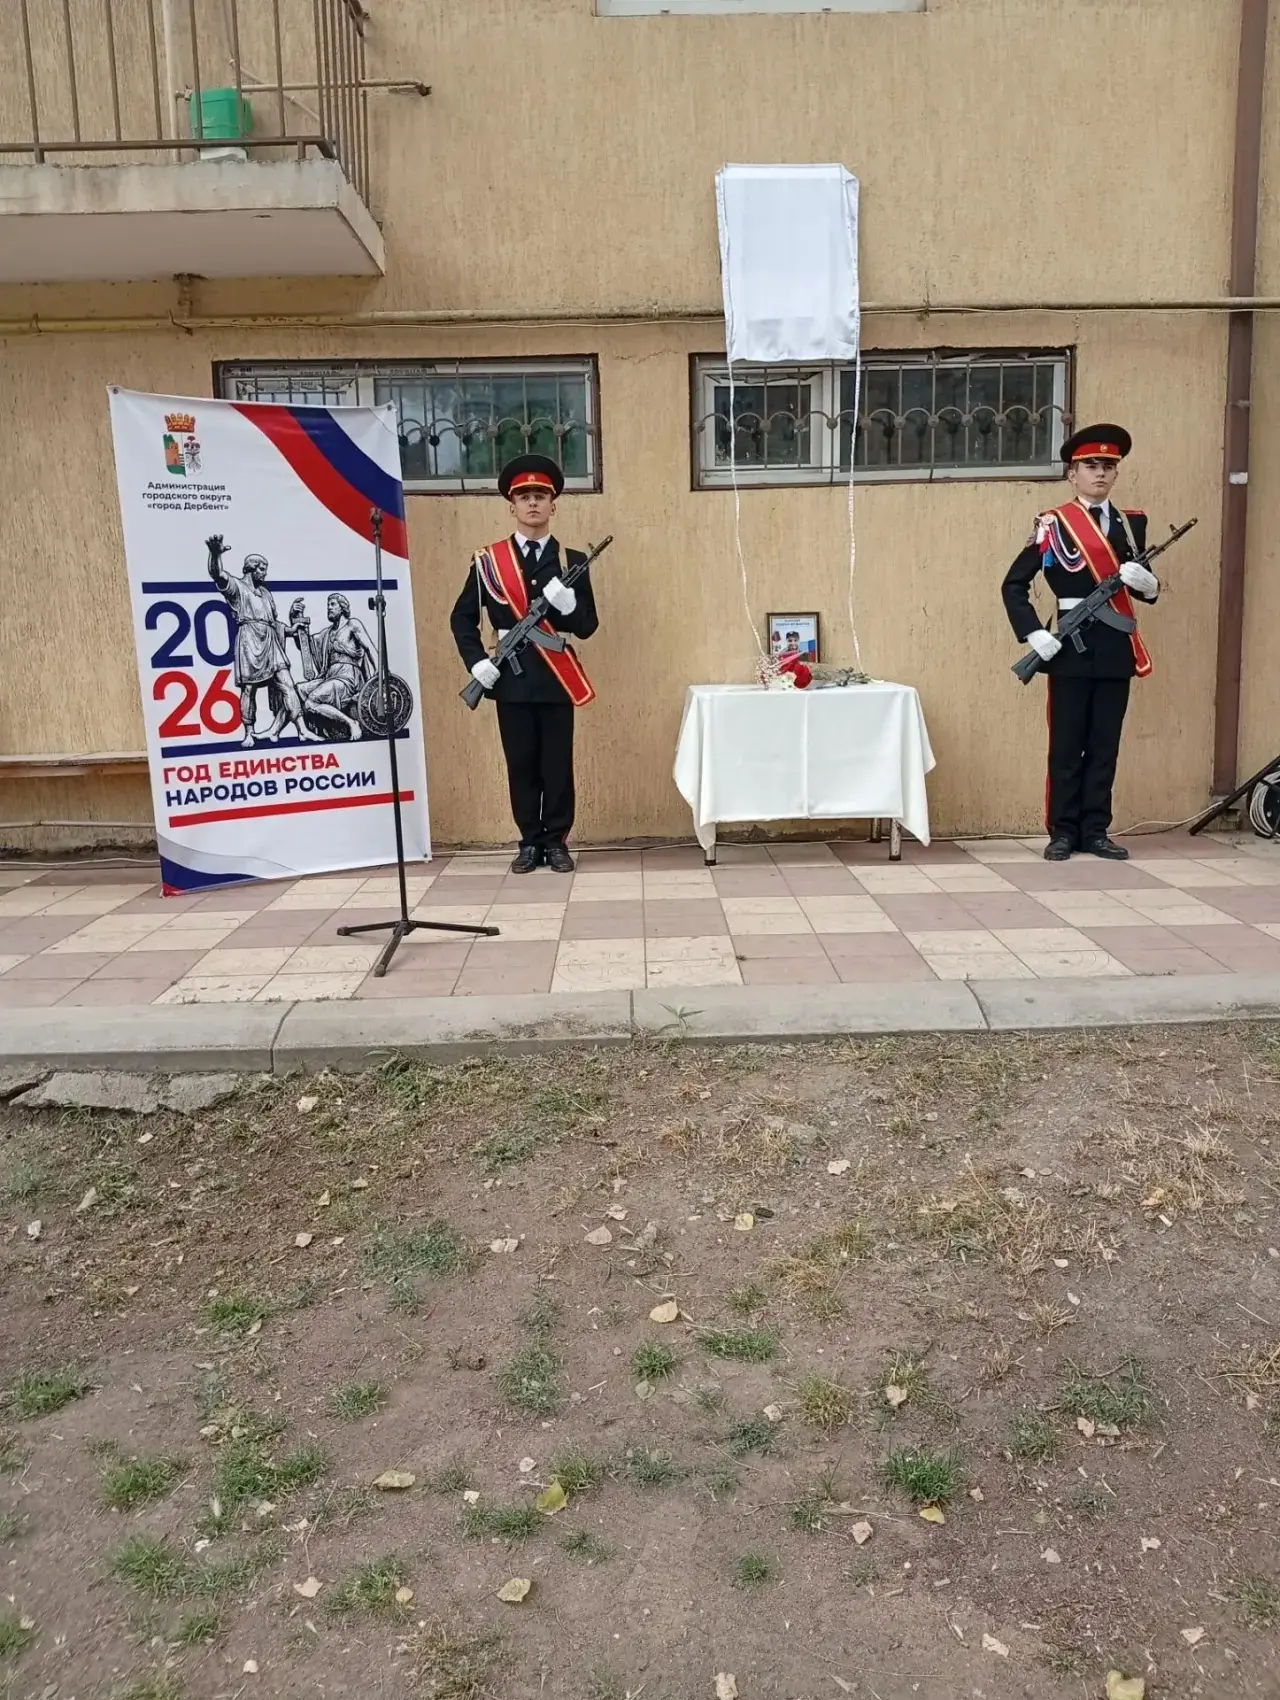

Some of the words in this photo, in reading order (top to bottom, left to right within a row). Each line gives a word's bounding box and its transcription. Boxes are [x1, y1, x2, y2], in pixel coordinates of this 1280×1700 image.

[142, 492, 198, 501] городского
[199, 493, 232, 503] округа
[147, 481, 226, 491] Администрация
[147, 502, 182, 511] «город
[184, 502, 229, 511] Дербент»
[144, 599, 240, 669] 20
[152, 669, 243, 739] 26
[163, 764, 212, 784] ГОД
[219, 752, 340, 779] ЕДИНСТВА
[166, 780, 278, 807] НАРОДОВ
[285, 770, 376, 794] РОССИИ
